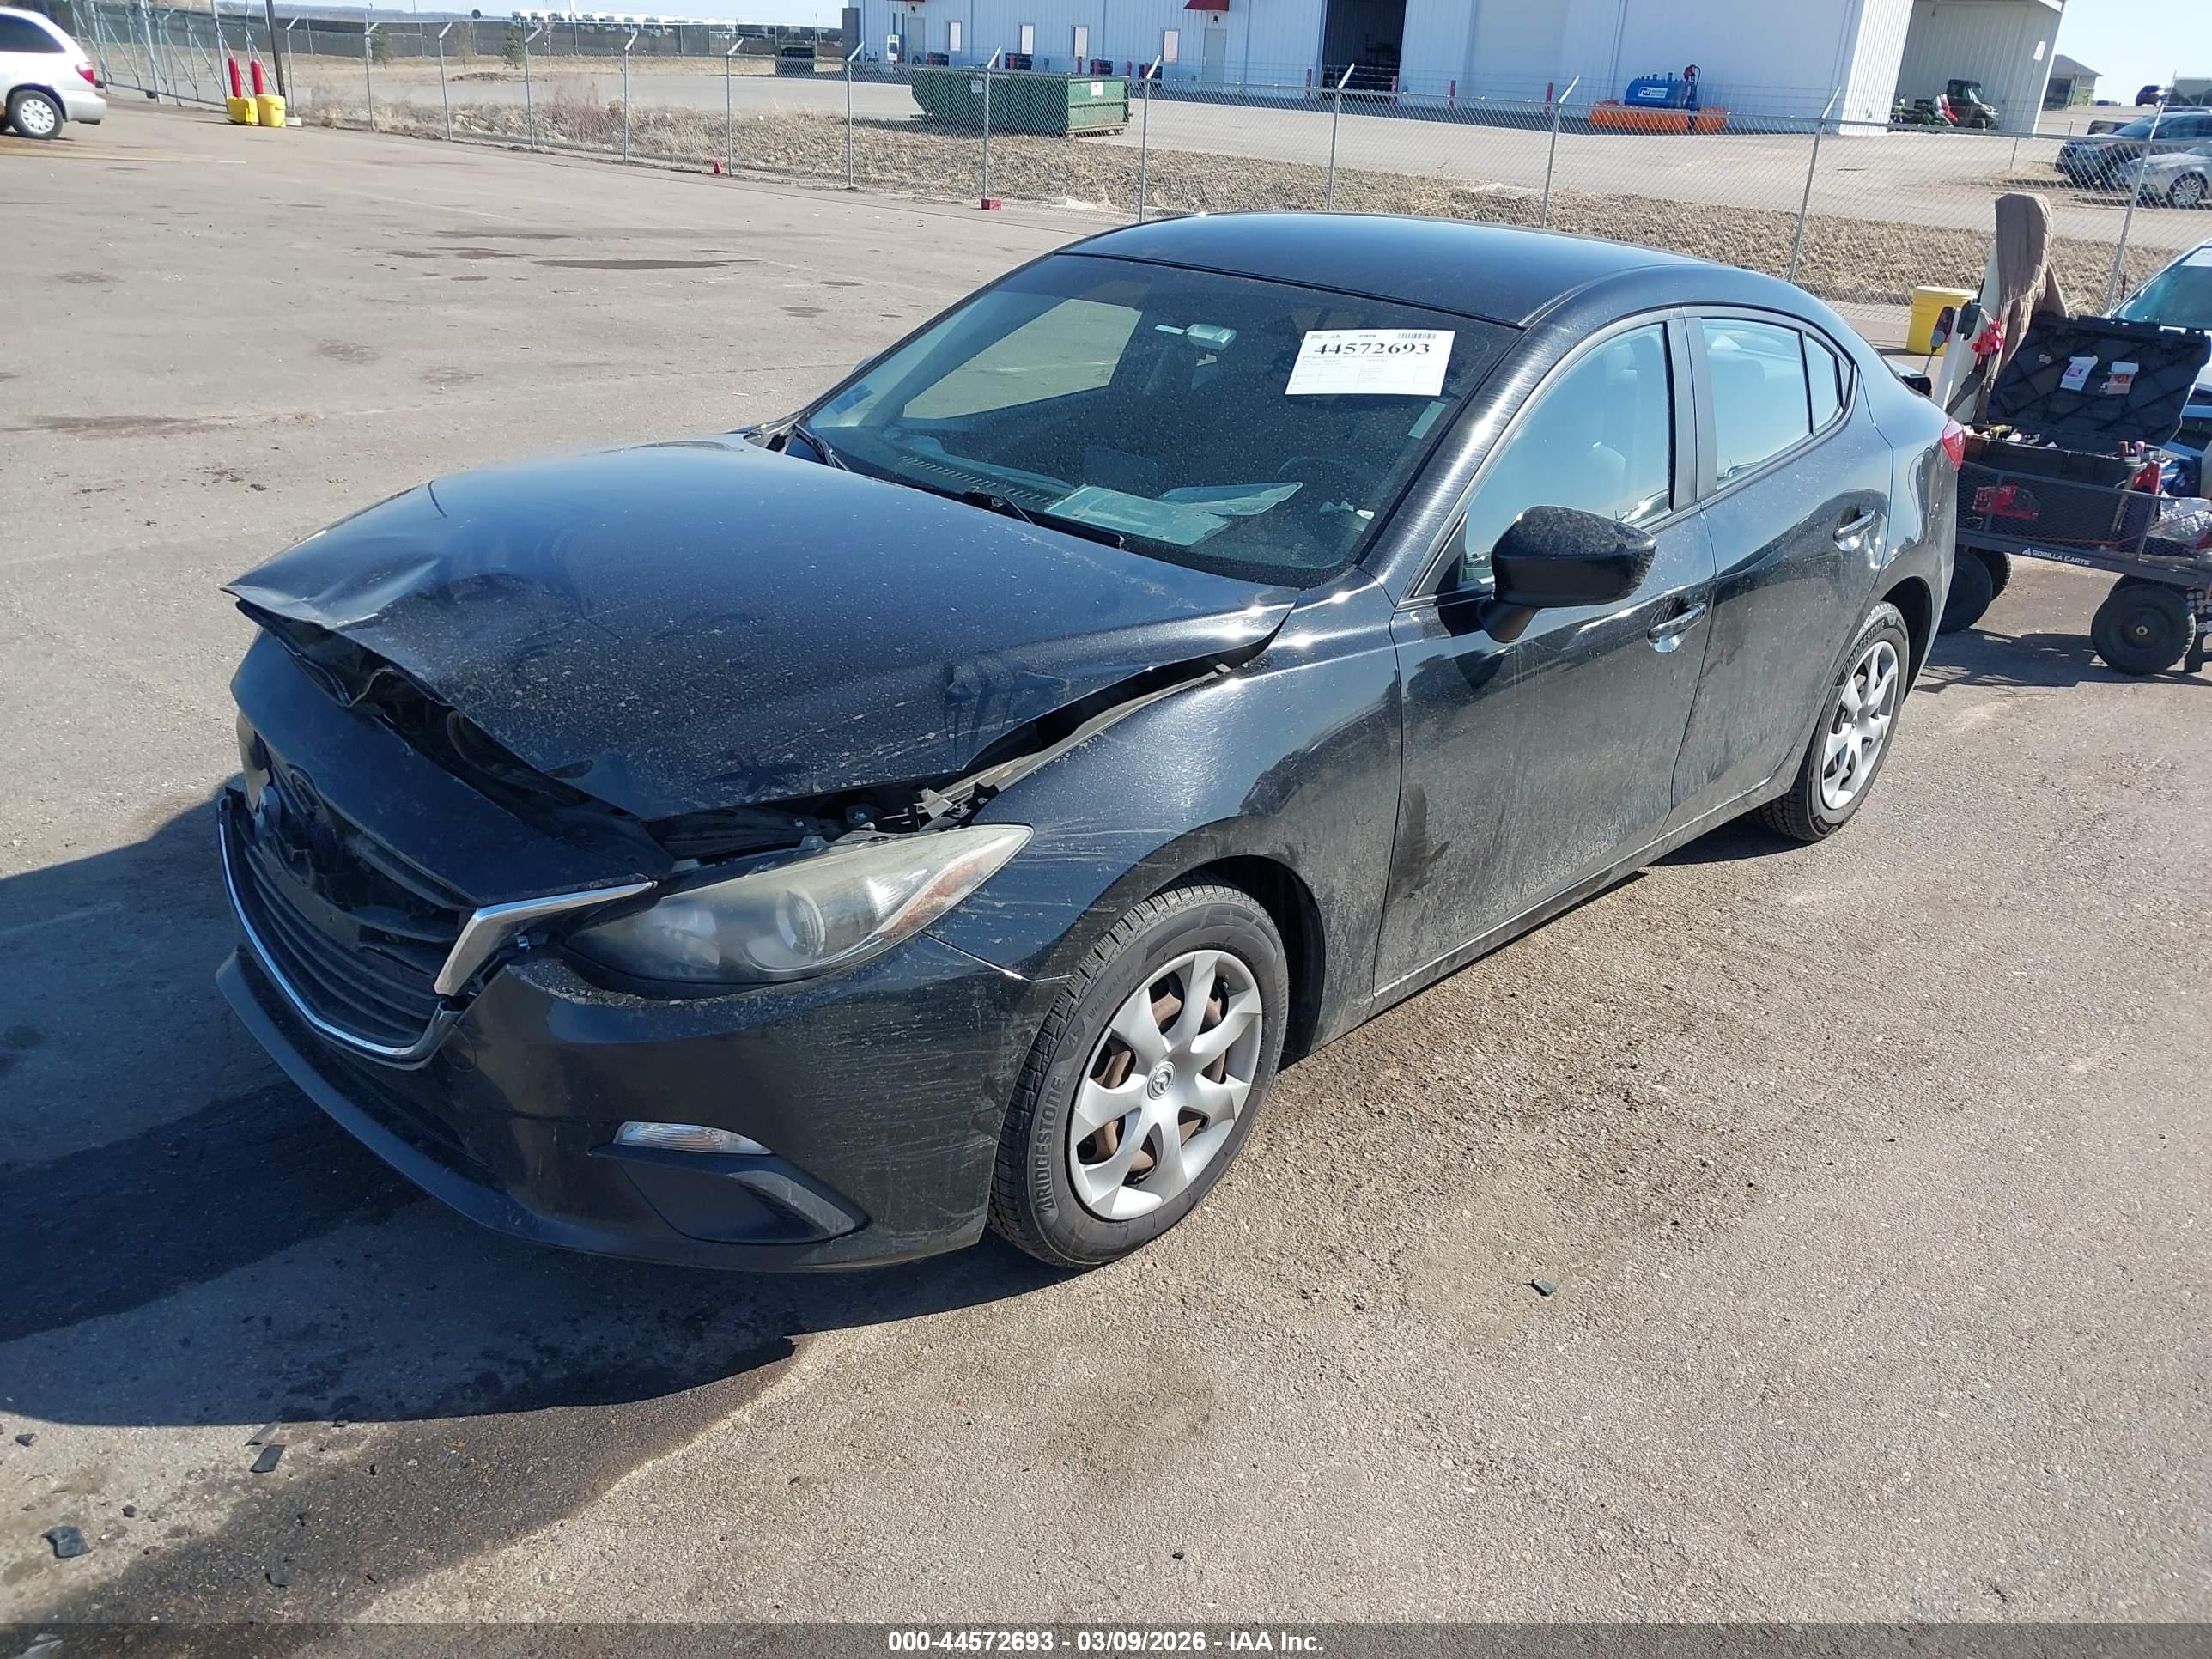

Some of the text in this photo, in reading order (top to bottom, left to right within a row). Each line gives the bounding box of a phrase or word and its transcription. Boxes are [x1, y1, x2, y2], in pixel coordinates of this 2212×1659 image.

[1314, 343, 1430, 355] 44572693
[2032, 550, 2063, 561] GORILLA
[1035, 1076, 1066, 1212] BRIDGESTONE
